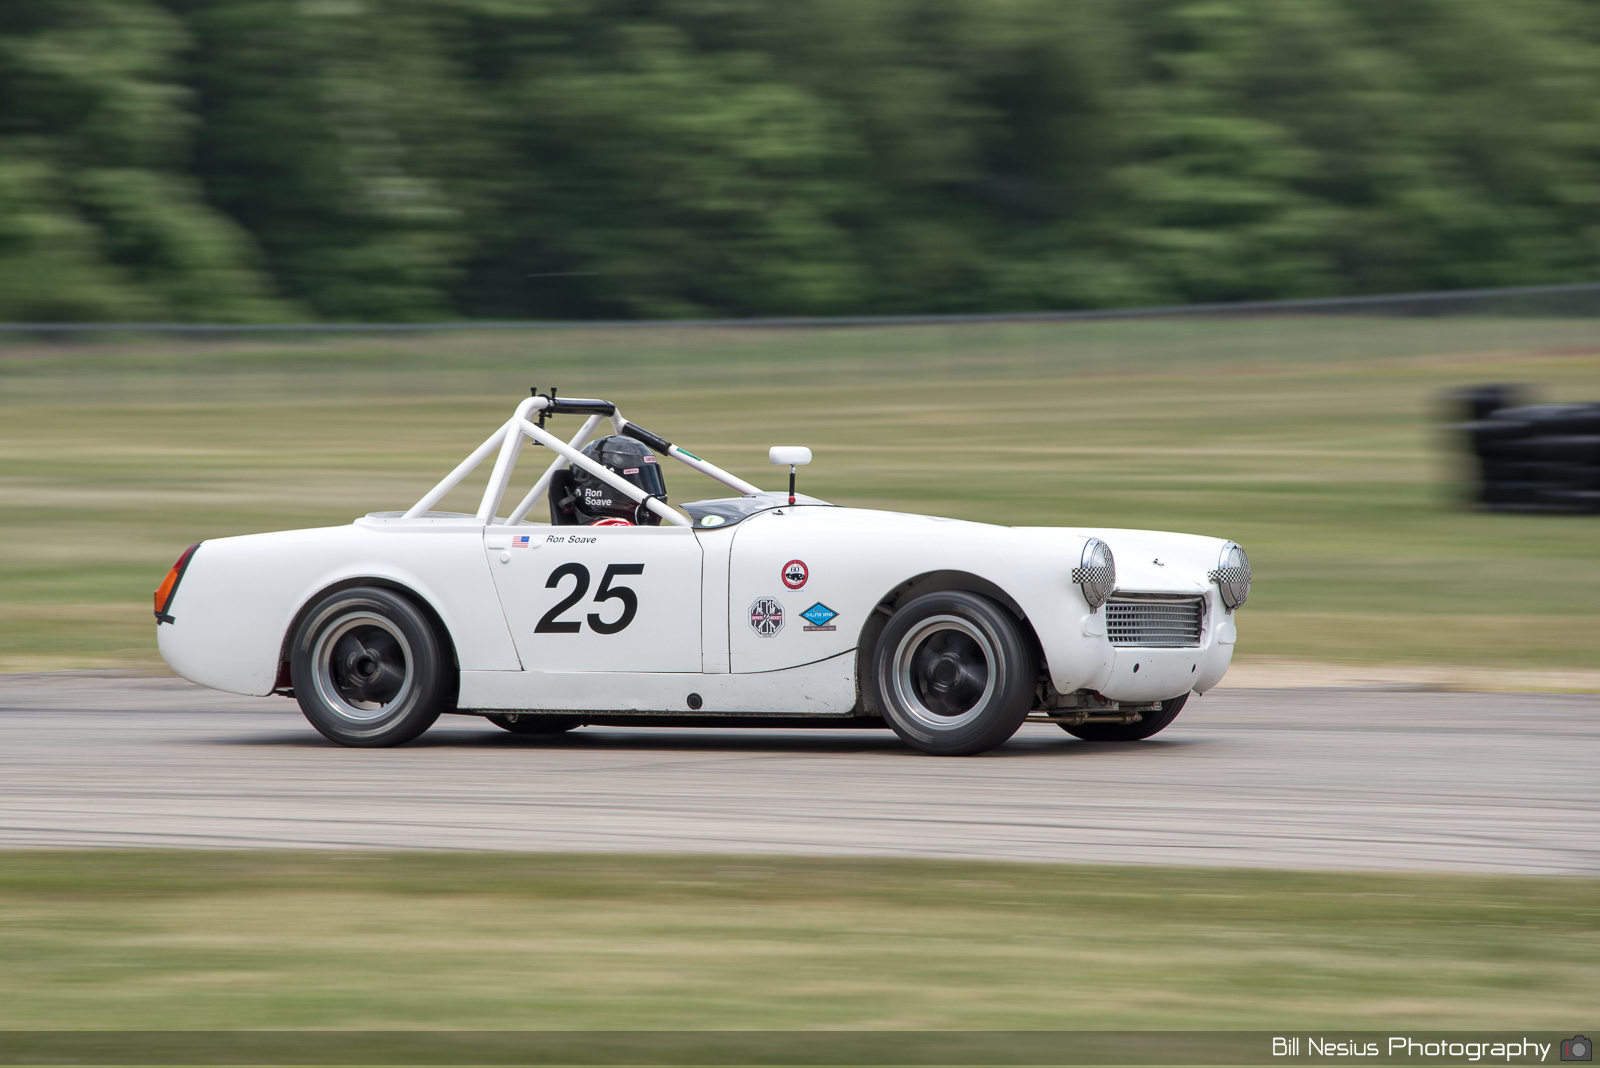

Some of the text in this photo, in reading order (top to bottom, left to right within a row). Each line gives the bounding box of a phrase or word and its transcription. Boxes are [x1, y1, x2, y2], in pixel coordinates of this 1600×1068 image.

[584, 488, 603, 497] Ron
[585, 497, 612, 506] Soave
[546, 535, 597, 544] Ron Soave
[533, 562, 645, 635] 25
